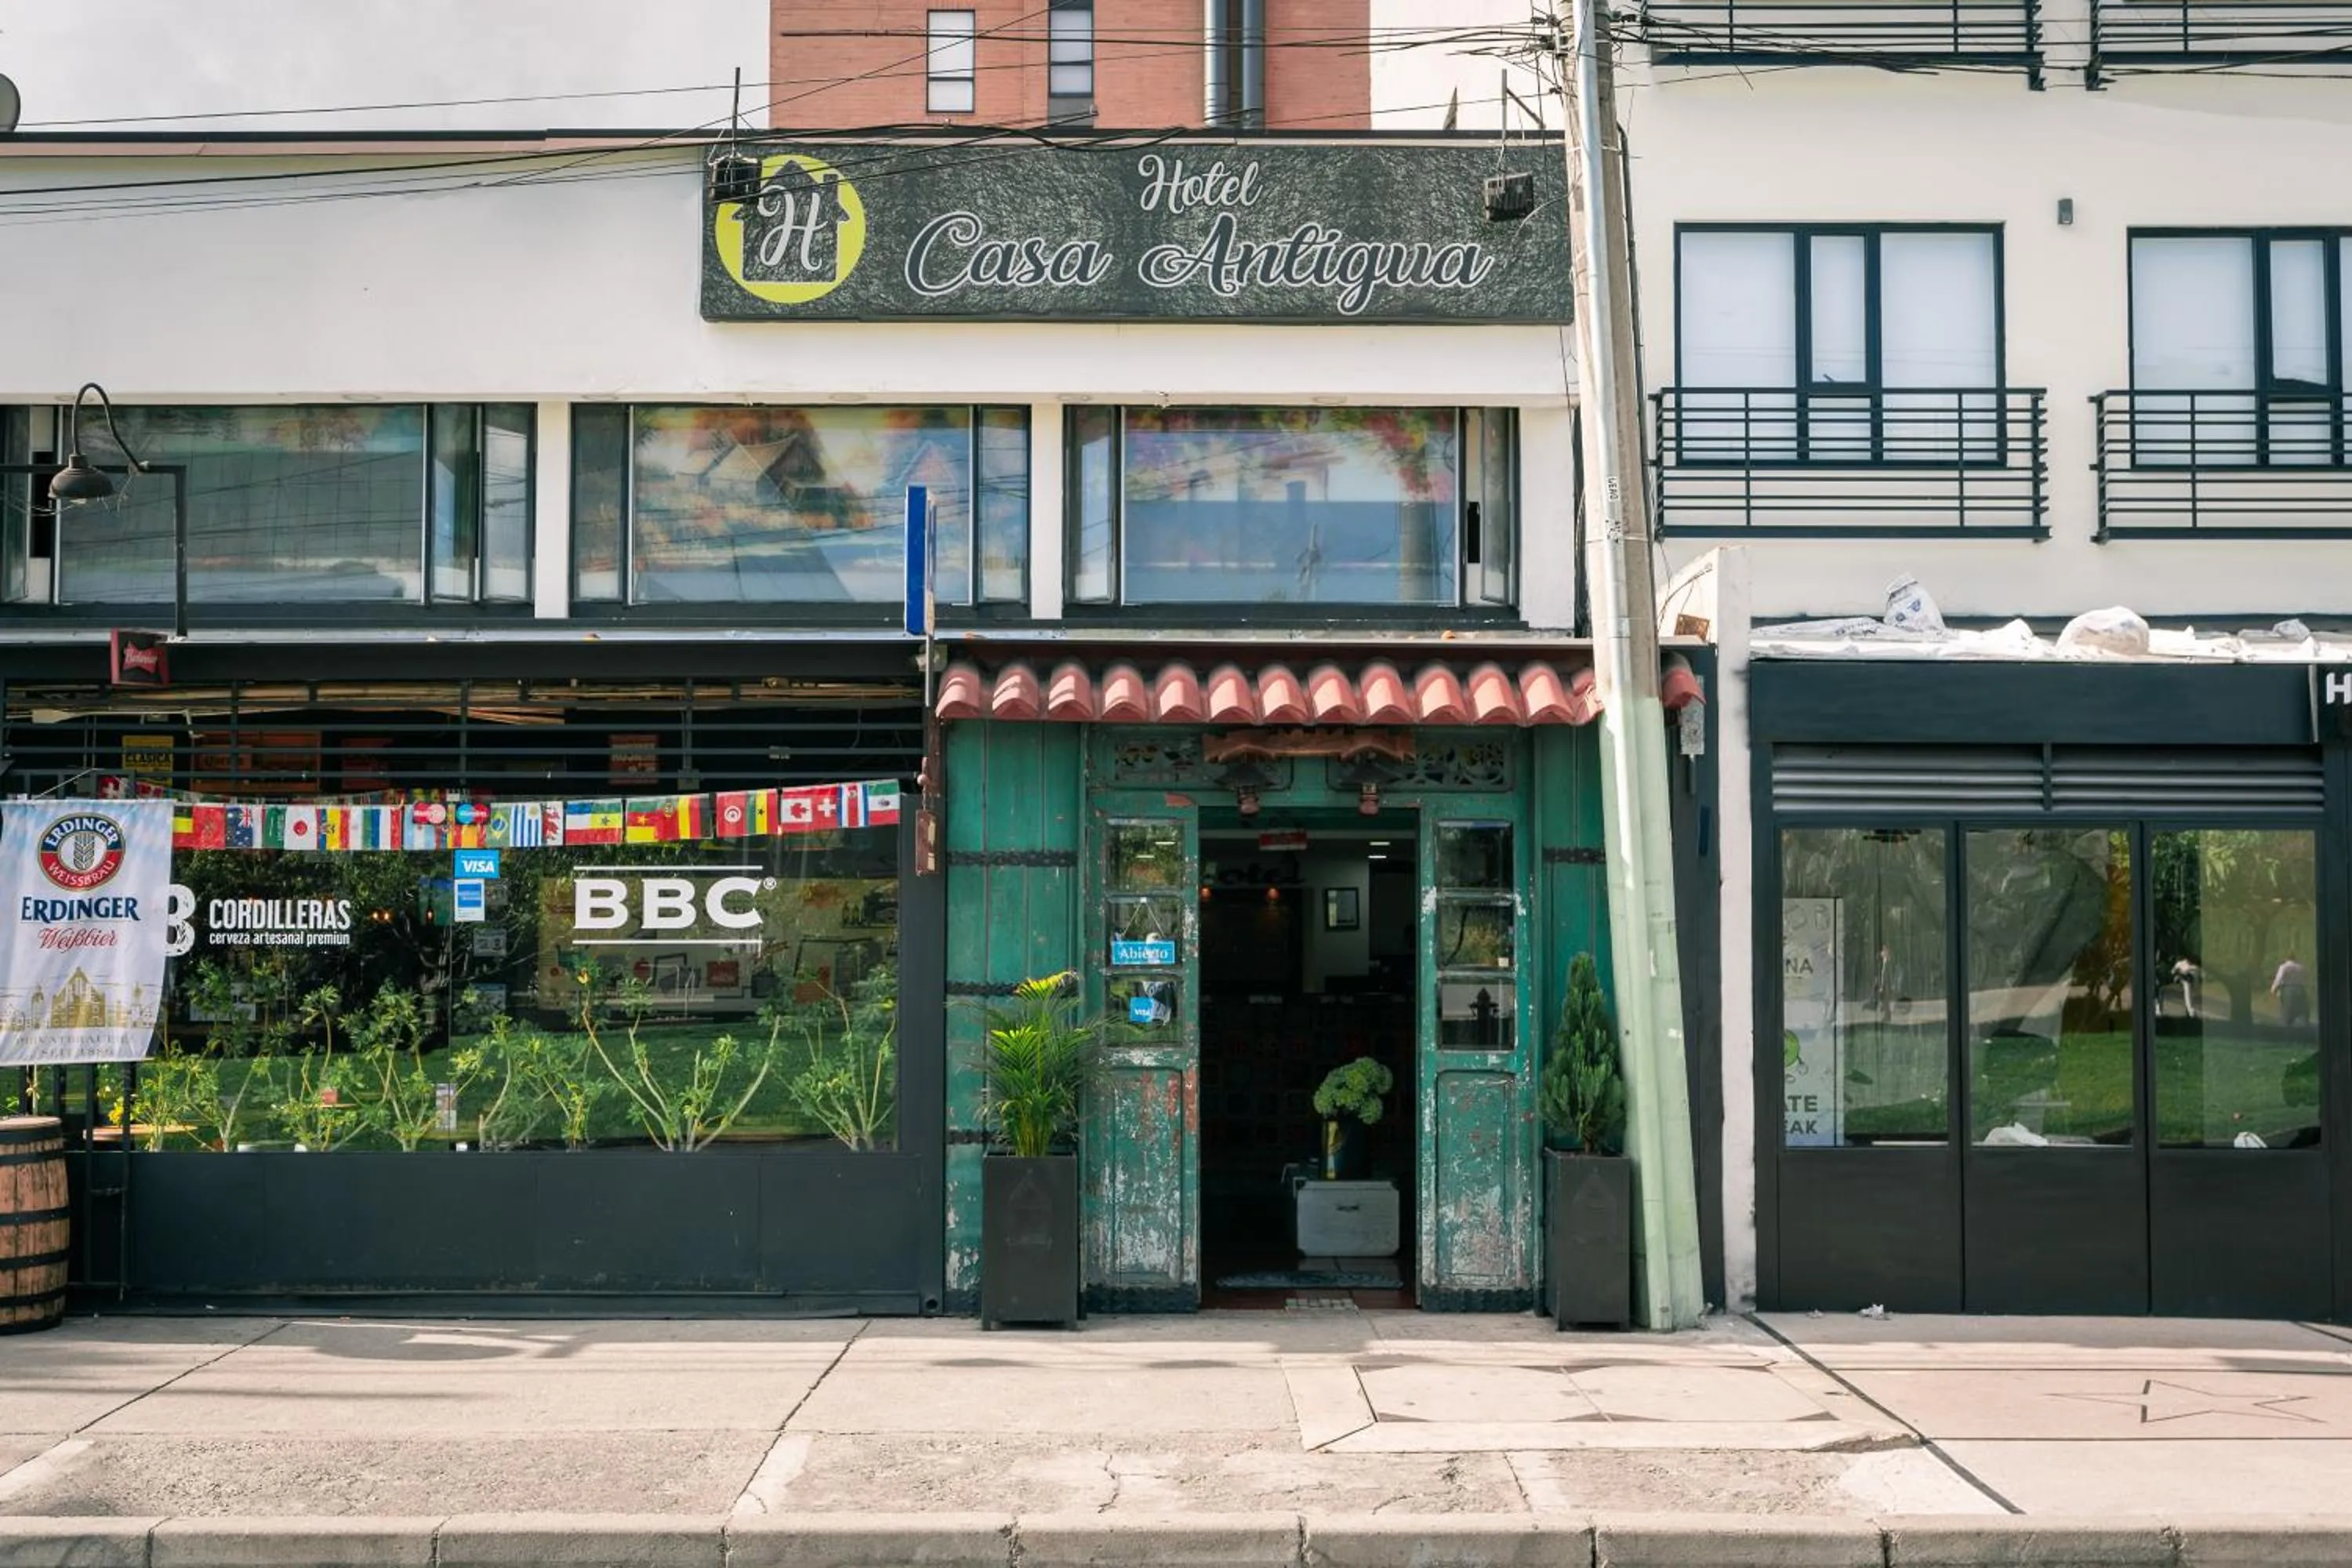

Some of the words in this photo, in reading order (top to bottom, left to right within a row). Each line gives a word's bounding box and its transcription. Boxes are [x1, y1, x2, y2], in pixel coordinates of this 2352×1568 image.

[1138, 154, 1263, 213] Hotel
[757, 185, 828, 271] H
[905, 211, 1113, 296] Casa
[1138, 212, 1494, 315] Antigua
[45, 818, 119, 847] ERDINGER
[462, 860, 495, 873] VISA
[21, 896, 141, 924] ERDINGER
[209, 898, 352, 930] CORDILLERAS
[573, 877, 764, 929] BBC
[209, 932, 250, 946] cerveza
[253, 931, 304, 946] artesanal
